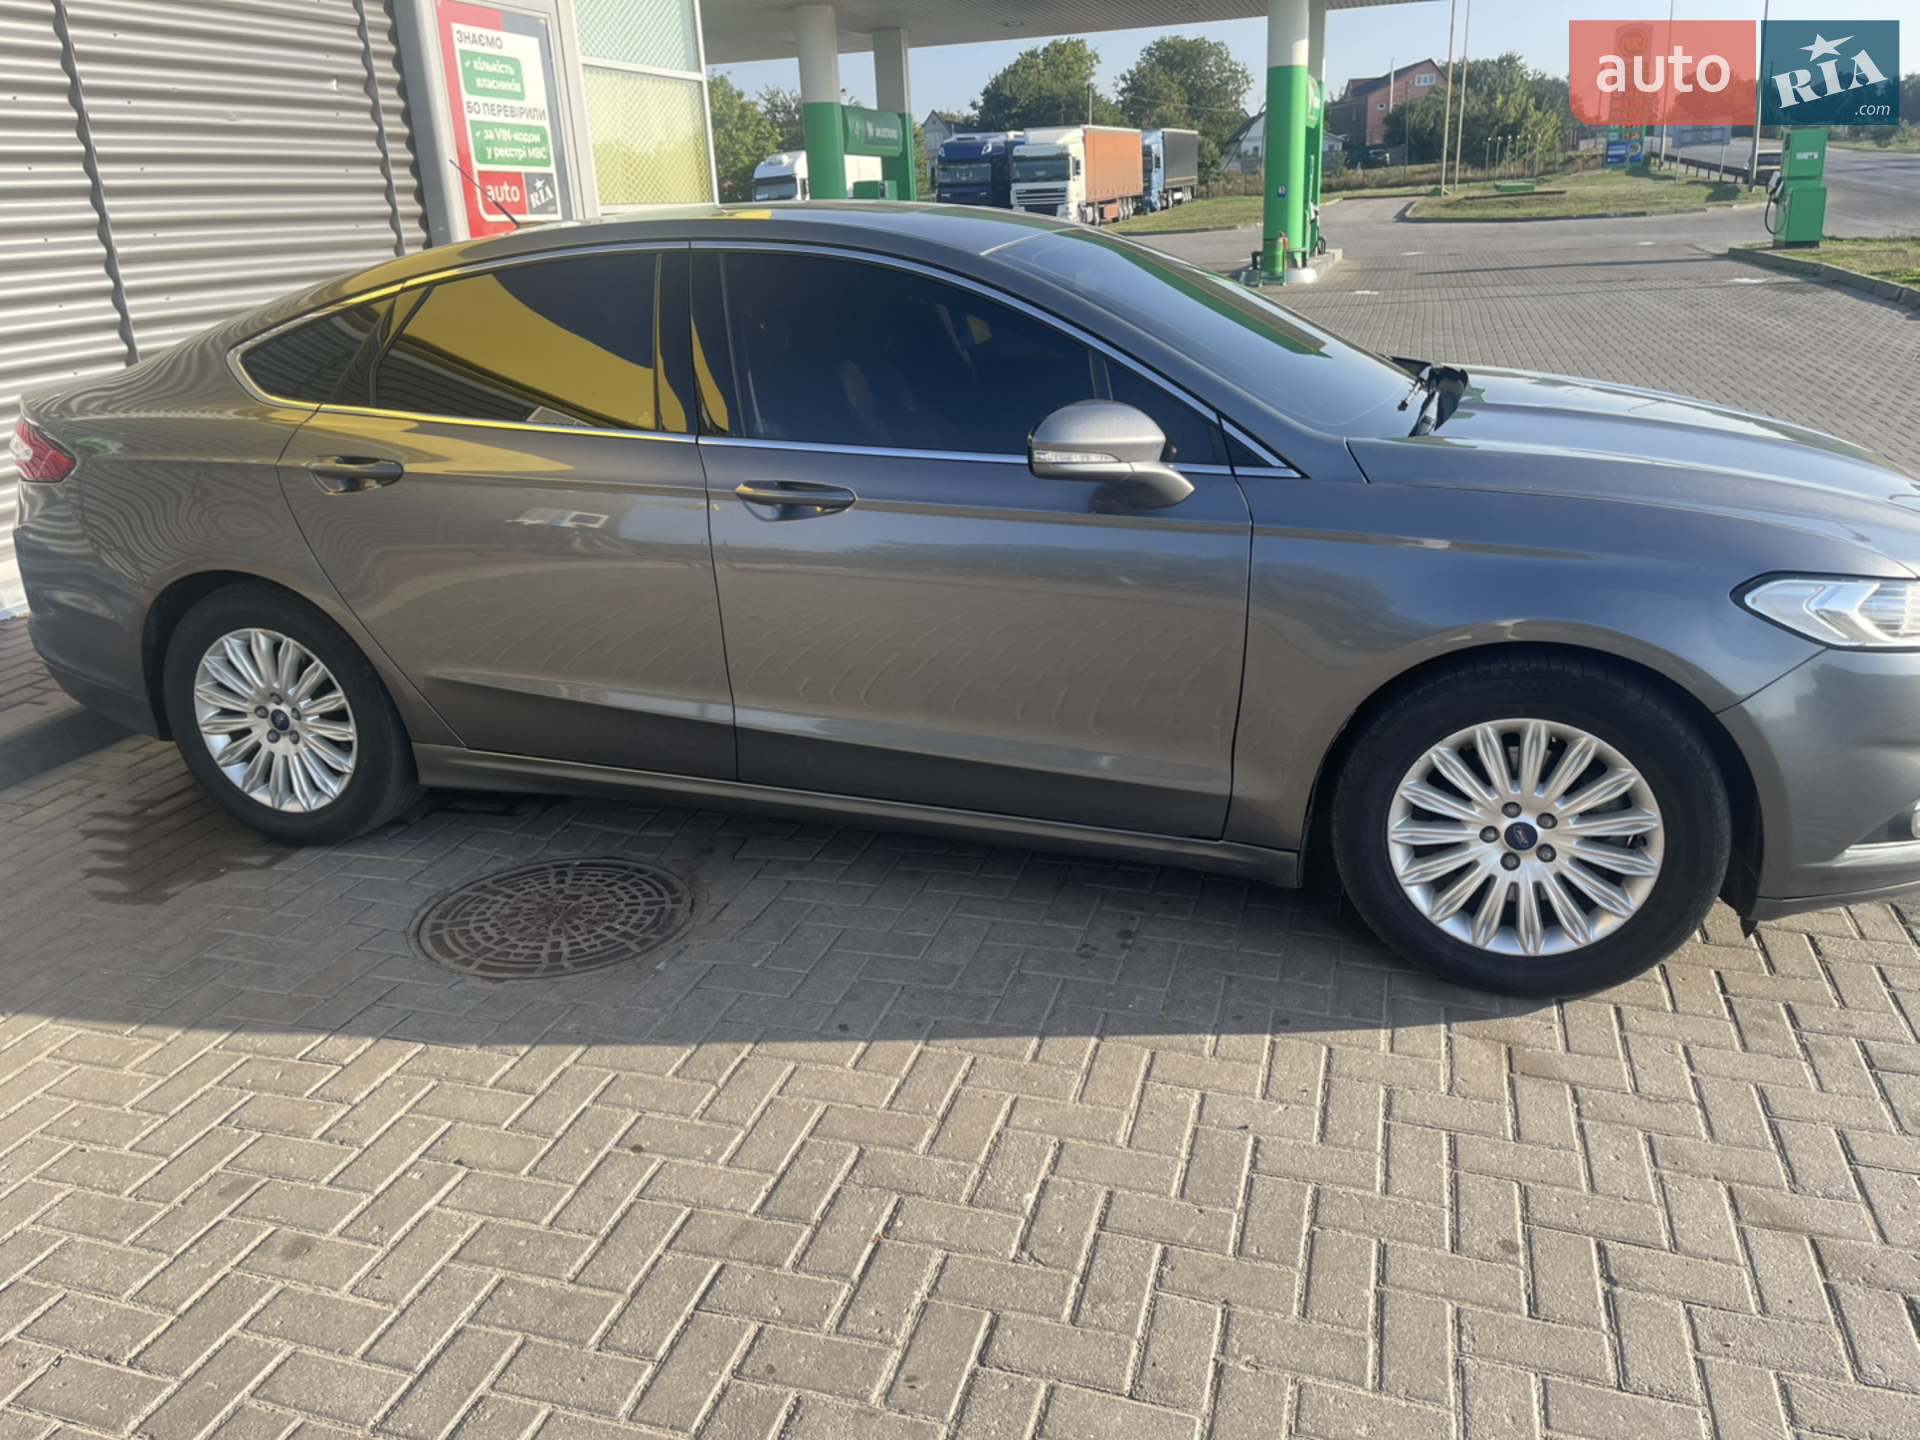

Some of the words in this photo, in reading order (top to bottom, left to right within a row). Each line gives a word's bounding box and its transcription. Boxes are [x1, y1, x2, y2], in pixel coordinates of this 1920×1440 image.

[456, 29, 504, 50] ЗНАЄМО
[472, 56, 515, 76] кількість
[475, 77, 522, 93] власників
[465, 100, 481, 115] БО
[482, 102, 547, 121] ПЕРЕВІРИЛИ
[483, 129, 495, 140] за
[494, 127, 542, 145] VIN-кодом
[494, 145, 527, 161] реєстрі
[527, 147, 548, 159] МВС
[485, 181, 521, 203] auto
[529, 184, 555, 209] RIA
